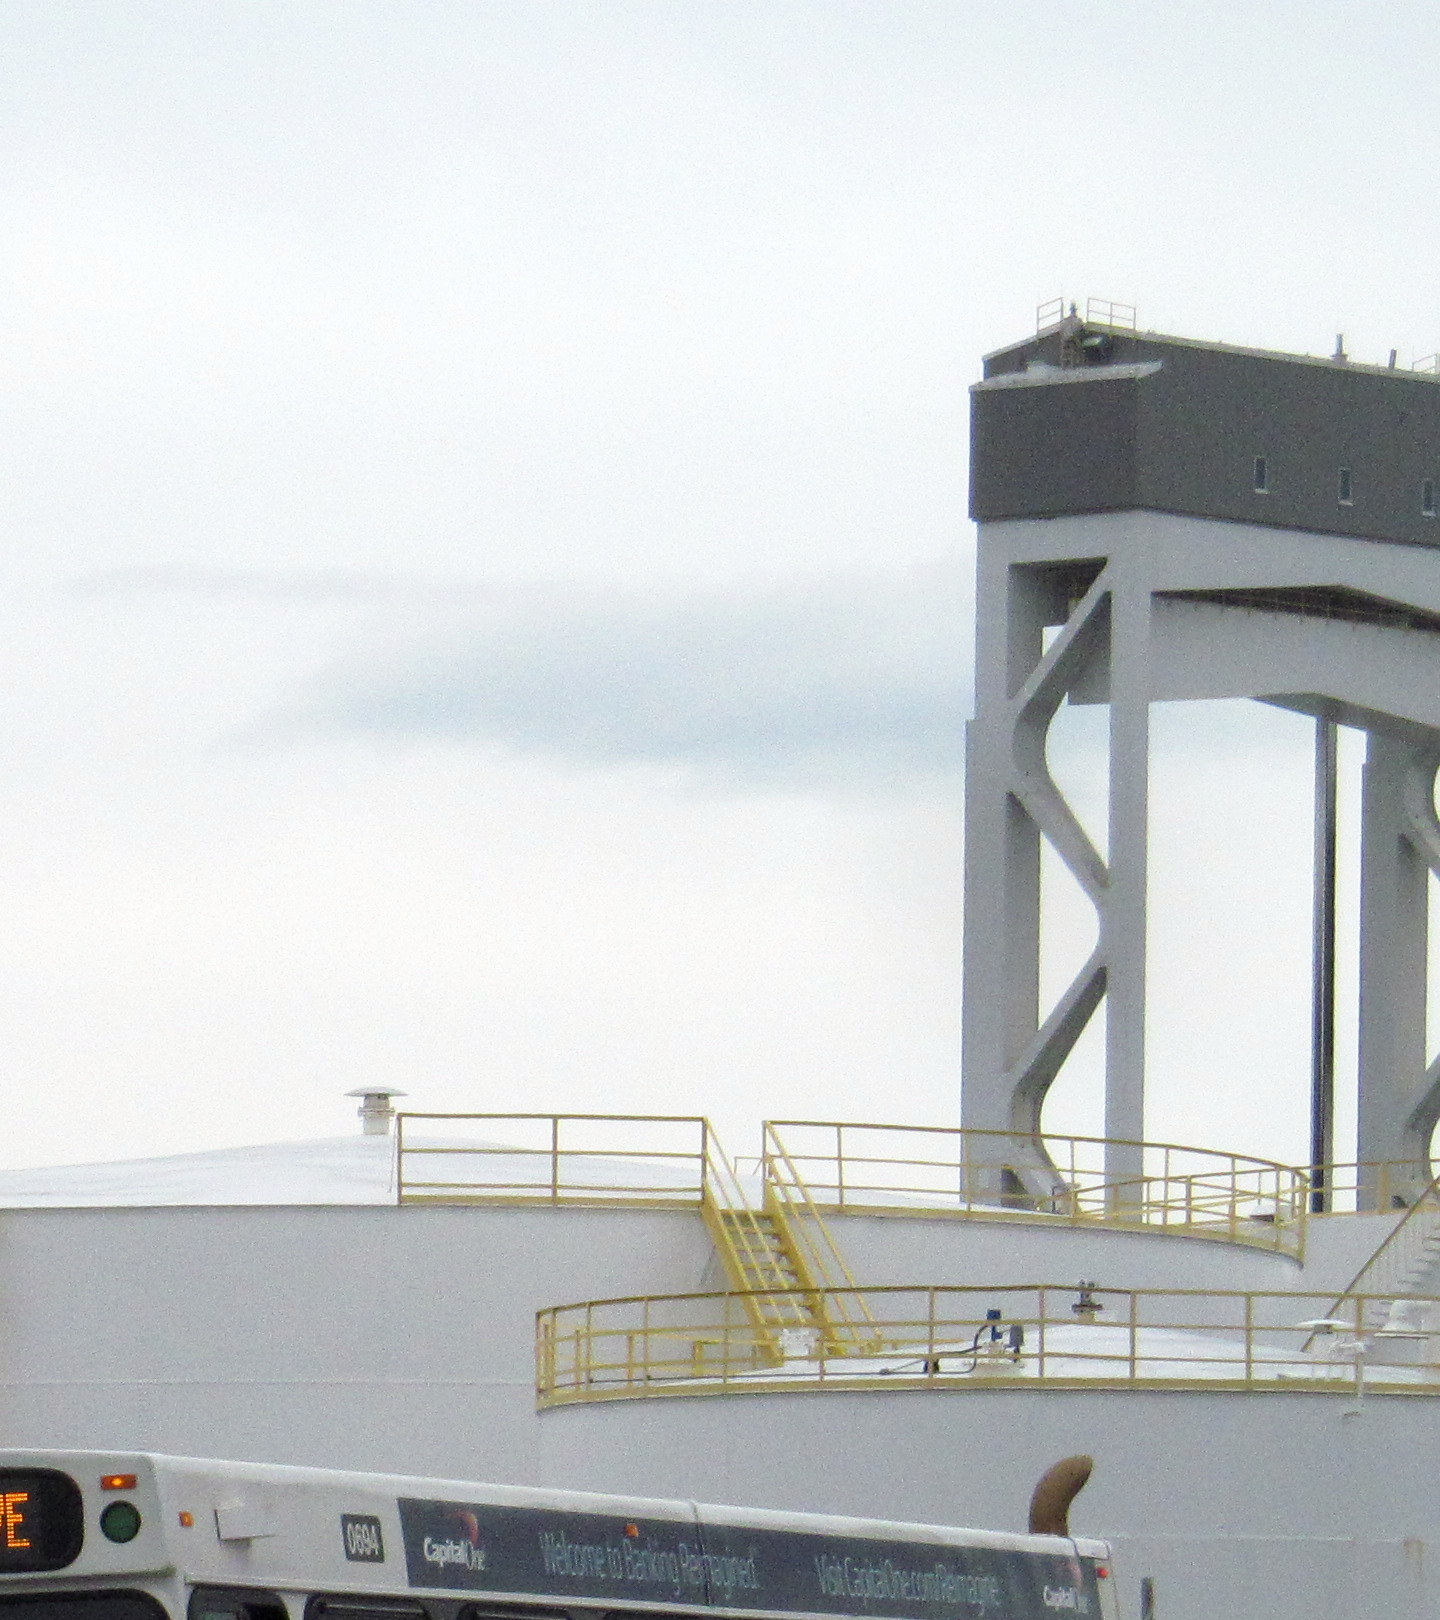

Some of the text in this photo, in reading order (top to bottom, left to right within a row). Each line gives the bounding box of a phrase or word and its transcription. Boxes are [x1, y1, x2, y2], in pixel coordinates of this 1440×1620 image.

[346, 1522, 380, 1556] 0694
[538, 1531, 606, 1577] Welcome
[606, 1543, 623, 1580] to
[623, 1538, 679, 1596] Banking
[815, 1554, 844, 1596] Visit
